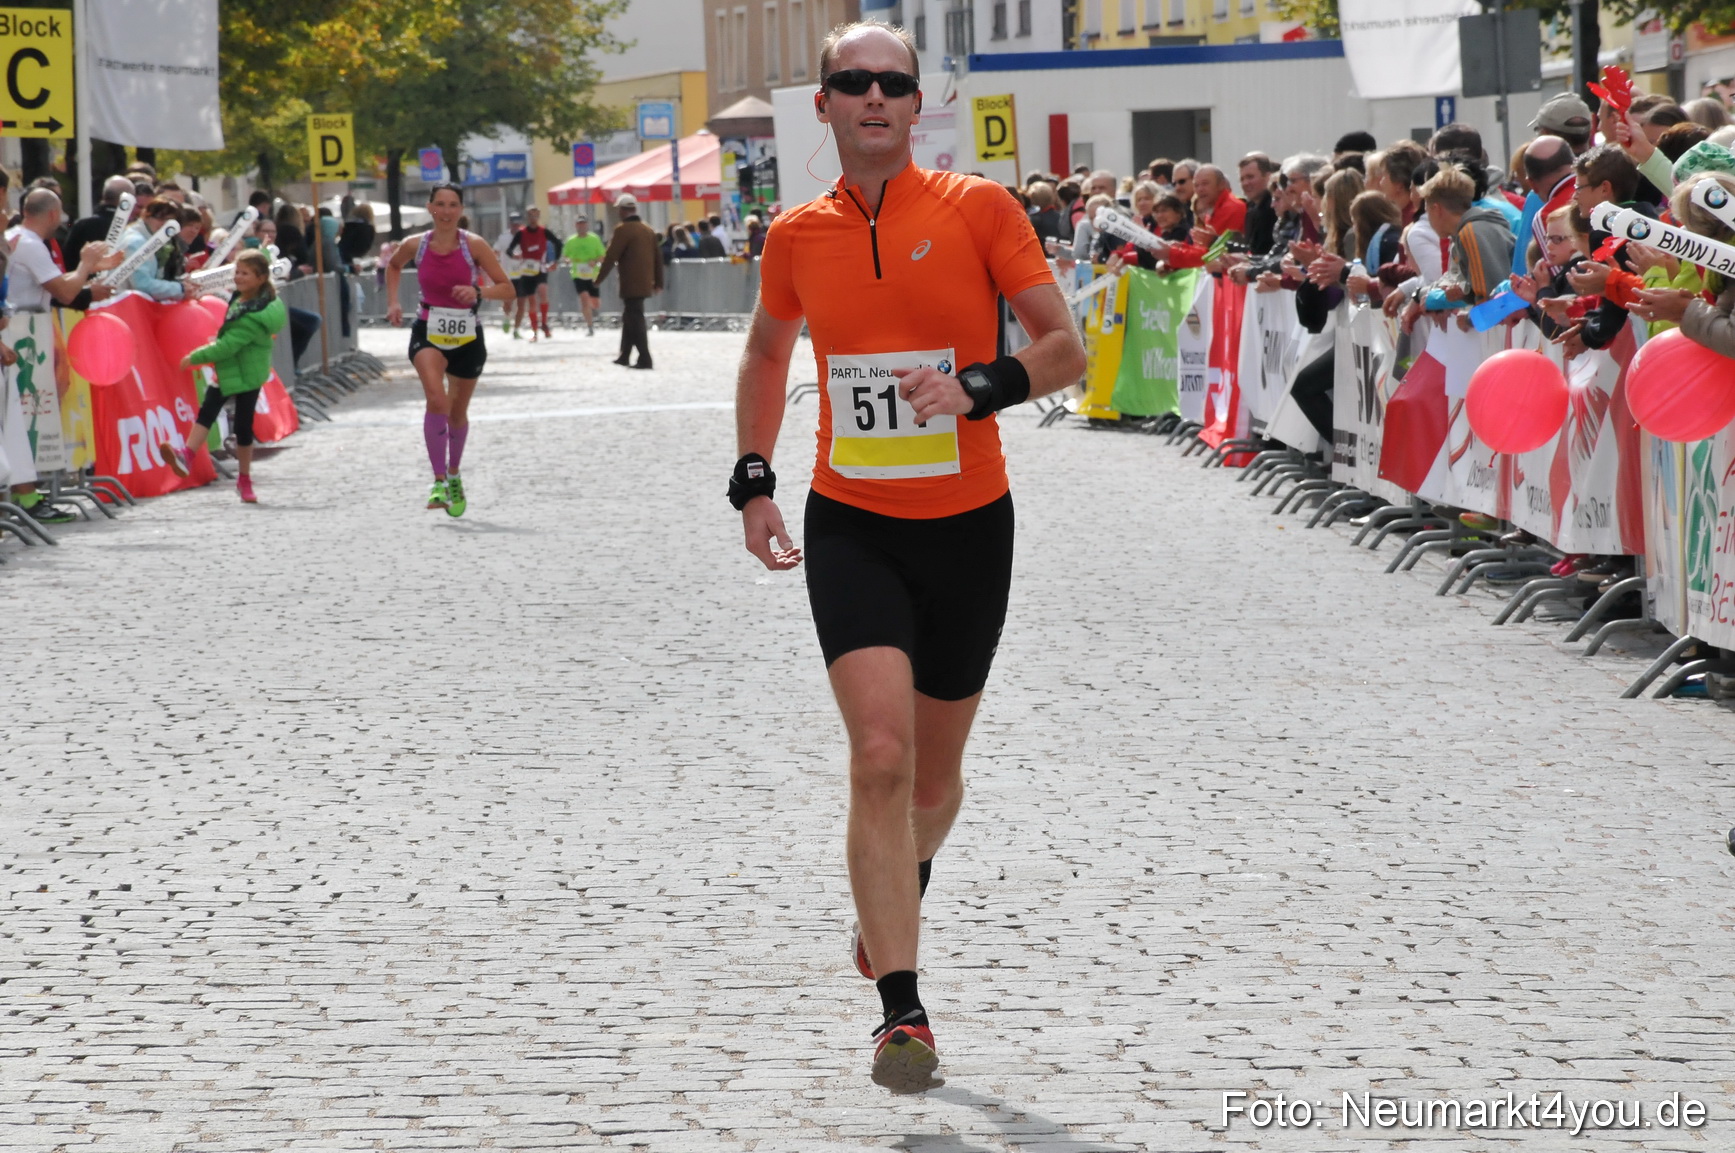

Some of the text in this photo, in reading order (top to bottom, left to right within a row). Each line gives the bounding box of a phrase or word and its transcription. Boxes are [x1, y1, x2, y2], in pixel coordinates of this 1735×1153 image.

[0, 14, 61, 37] Block
[7, 47, 51, 110] C
[977, 98, 1009, 111] Block
[313, 117, 347, 130] Block
[984, 115, 1007, 147] D
[320, 135, 343, 167] D
[1657, 230, 1708, 261] BMW
[437, 318, 467, 334] 386
[831, 366, 867, 379] PARTL
[852, 385, 927, 431] 51
